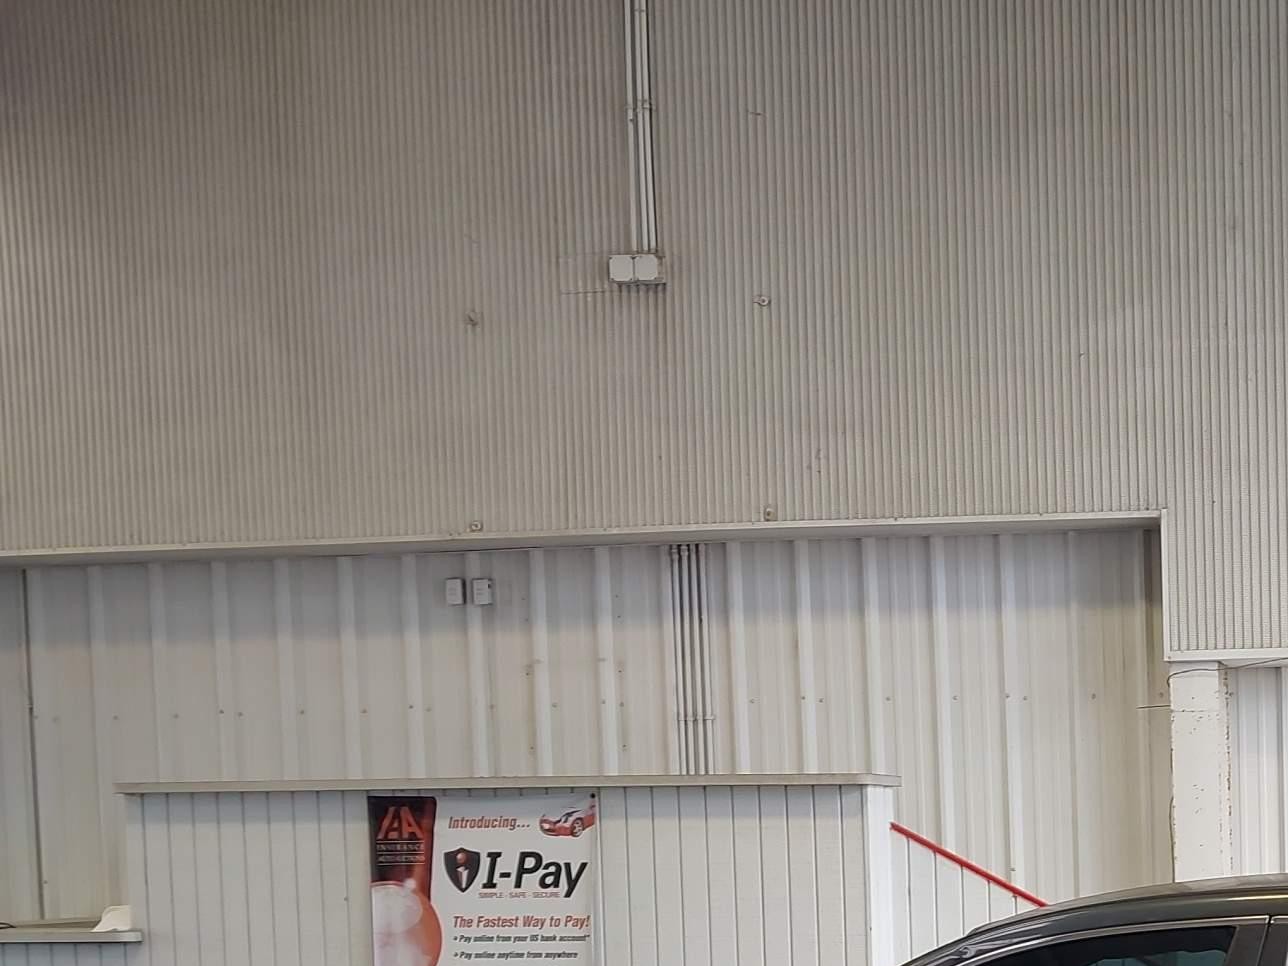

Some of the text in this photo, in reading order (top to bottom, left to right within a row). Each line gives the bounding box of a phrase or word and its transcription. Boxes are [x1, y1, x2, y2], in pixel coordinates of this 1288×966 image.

[448, 816, 530, 830] Introducing...
[482, 851, 588, 898] I-Pay
[453, 915, 591, 930] The Fastest Way to Pay!
[459, 934, 473, 944] Pay
[473, 934, 495, 942] online
[496, 934, 512, 942] from
[513, 935, 529, 944] your
[540, 934, 557, 942] bank
[459, 951, 578, 960] Pay online anytime from anywhere
